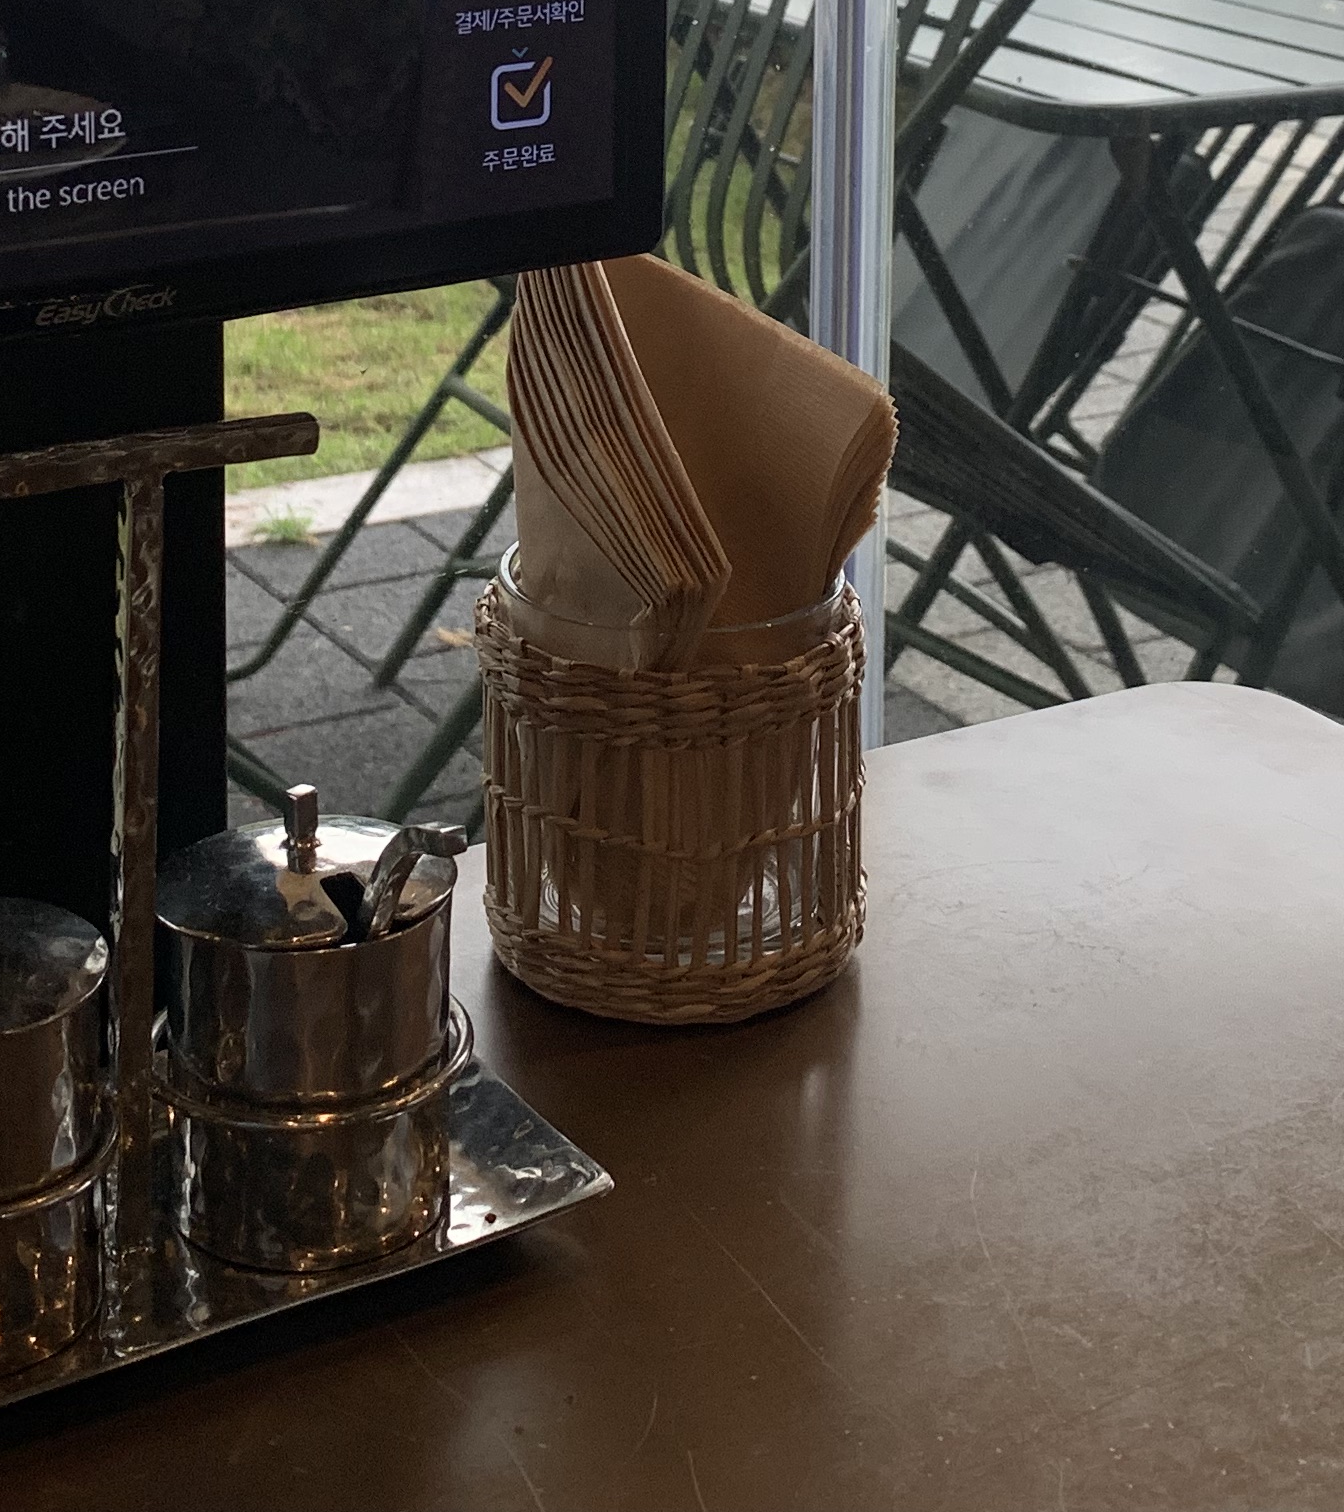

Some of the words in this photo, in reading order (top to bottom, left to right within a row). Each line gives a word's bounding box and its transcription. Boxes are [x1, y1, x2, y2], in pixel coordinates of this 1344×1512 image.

[39, 108, 127, 150] 주세요
[482, 142, 556, 172] 주문완료
[7, 186, 52, 214] the
[58, 175, 146, 207] screen
